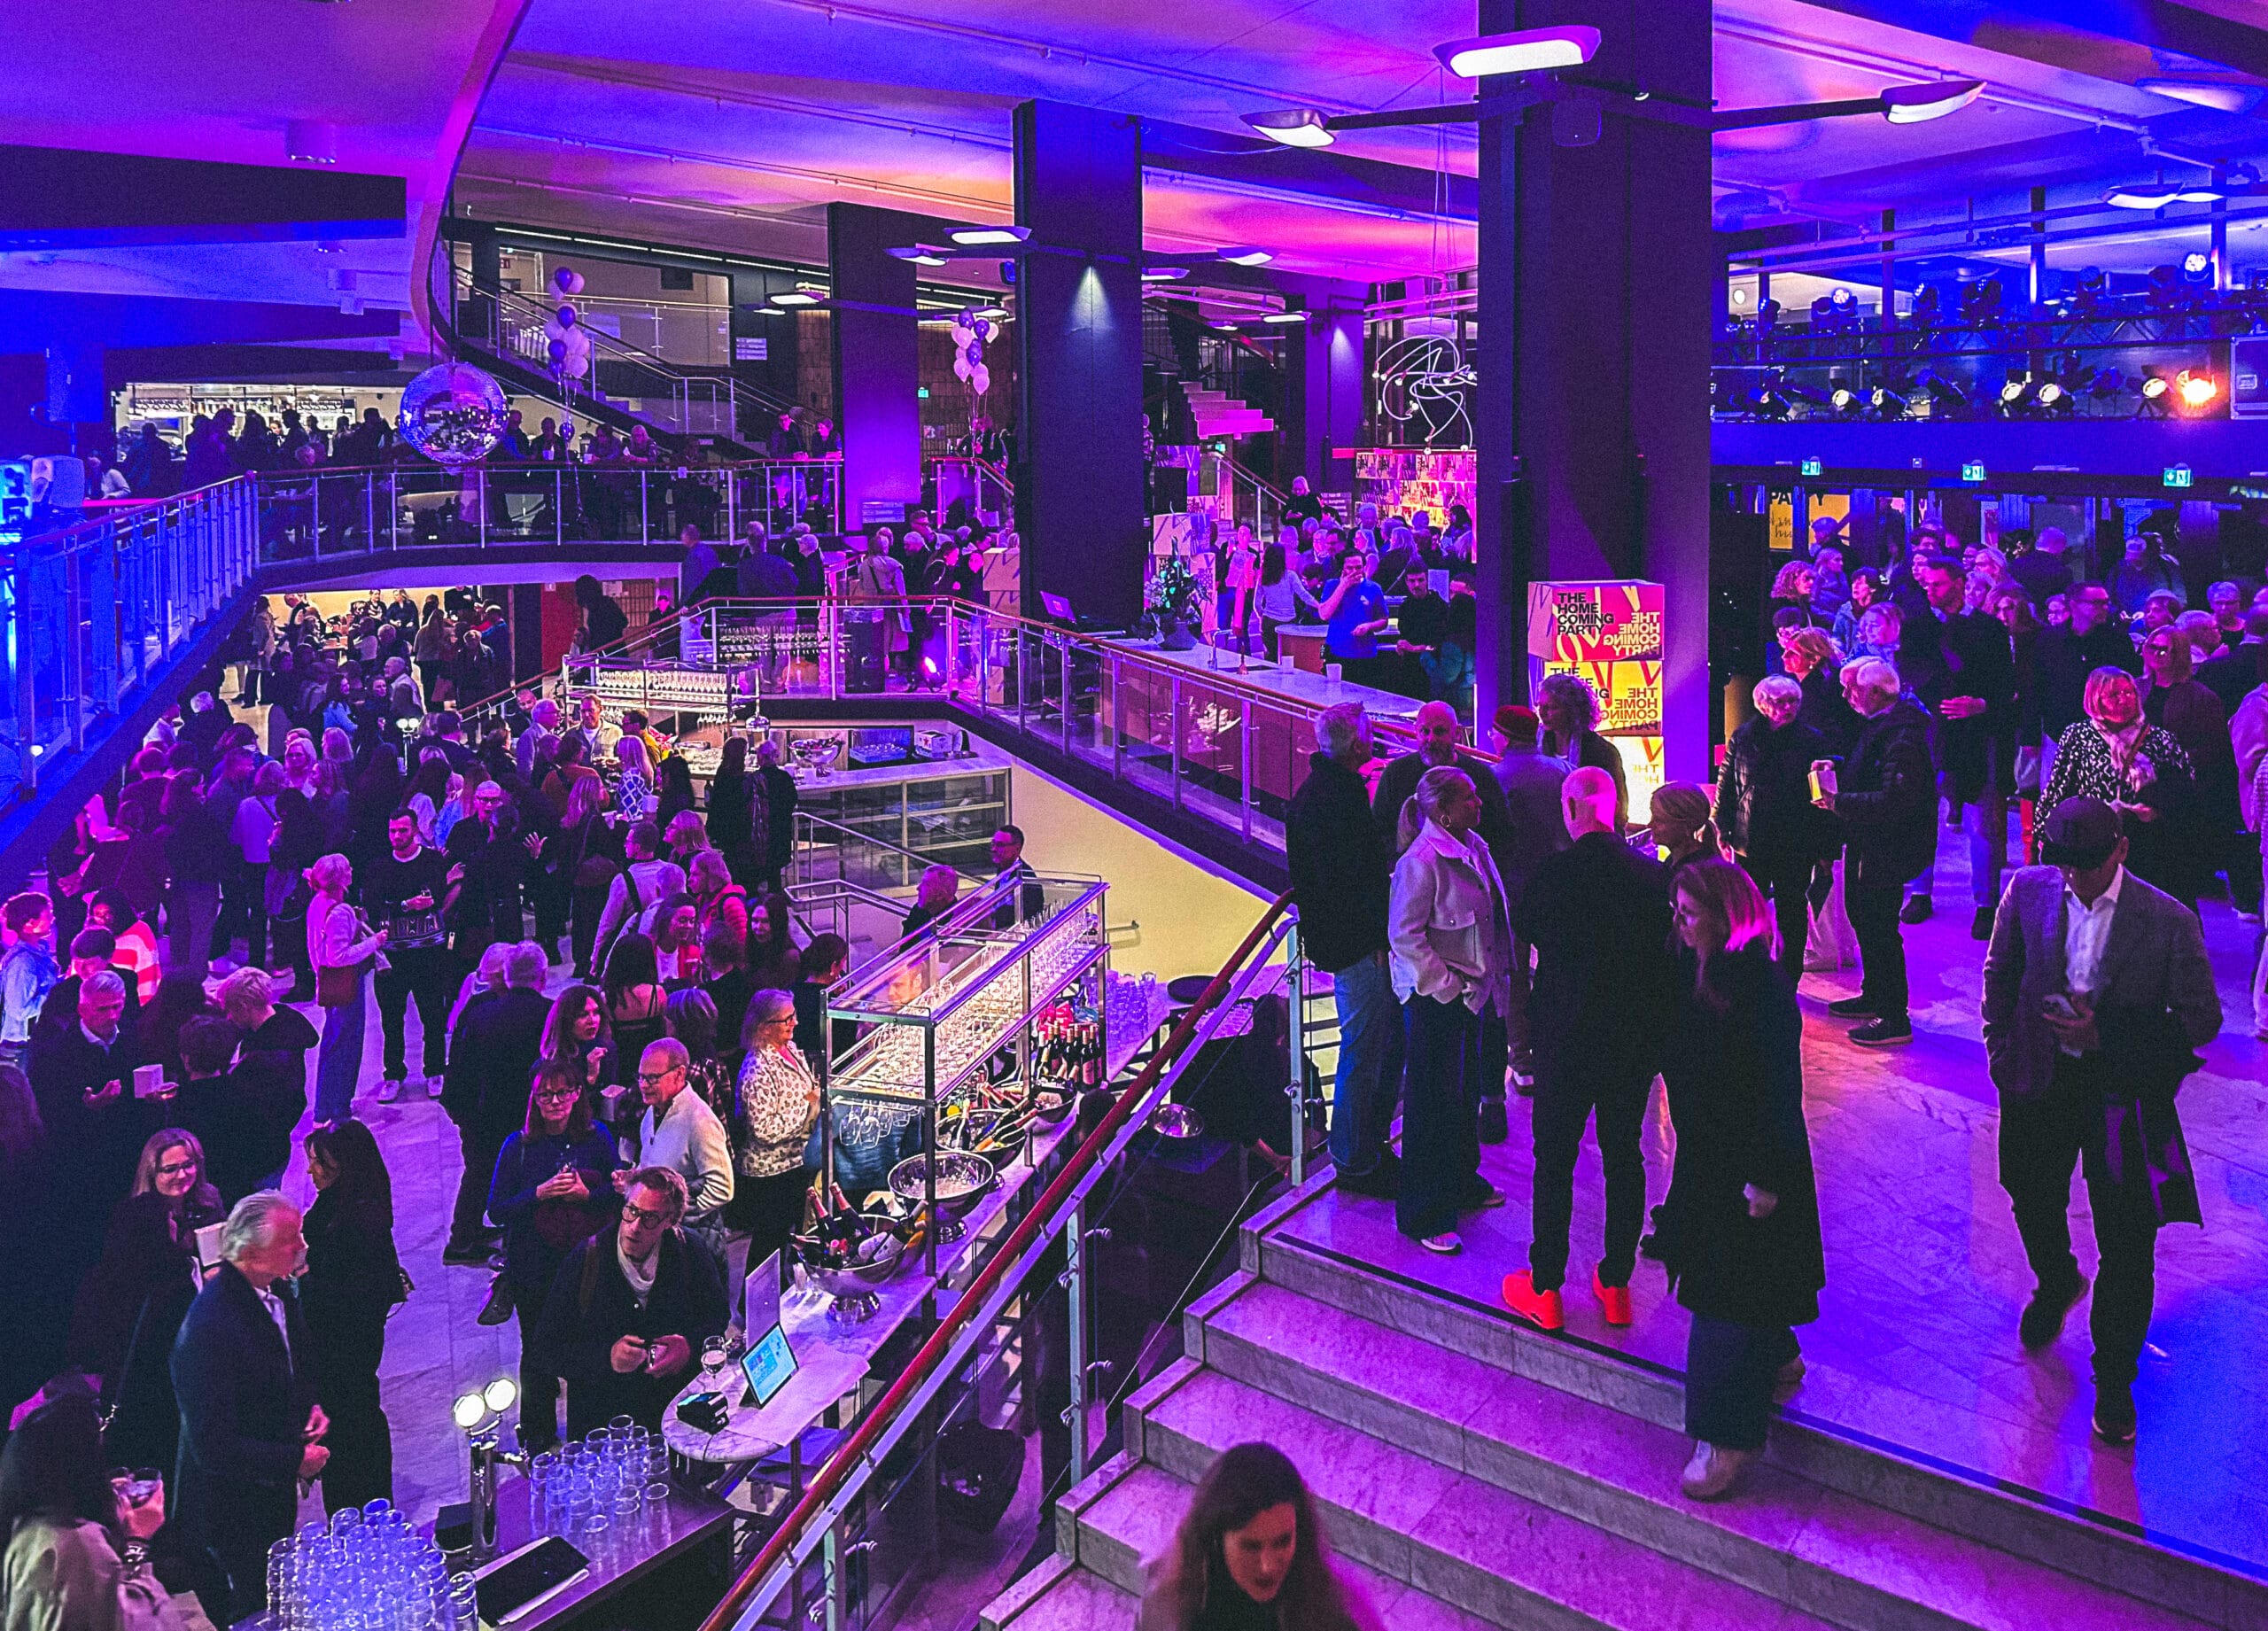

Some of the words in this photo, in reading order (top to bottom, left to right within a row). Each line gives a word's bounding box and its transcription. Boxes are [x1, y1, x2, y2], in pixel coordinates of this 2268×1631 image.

[1557, 593, 1586, 603] THE
[1557, 603, 1599, 614] HOME
[1557, 613, 1614, 625] COMING
[1557, 625, 1604, 635] PARTY
